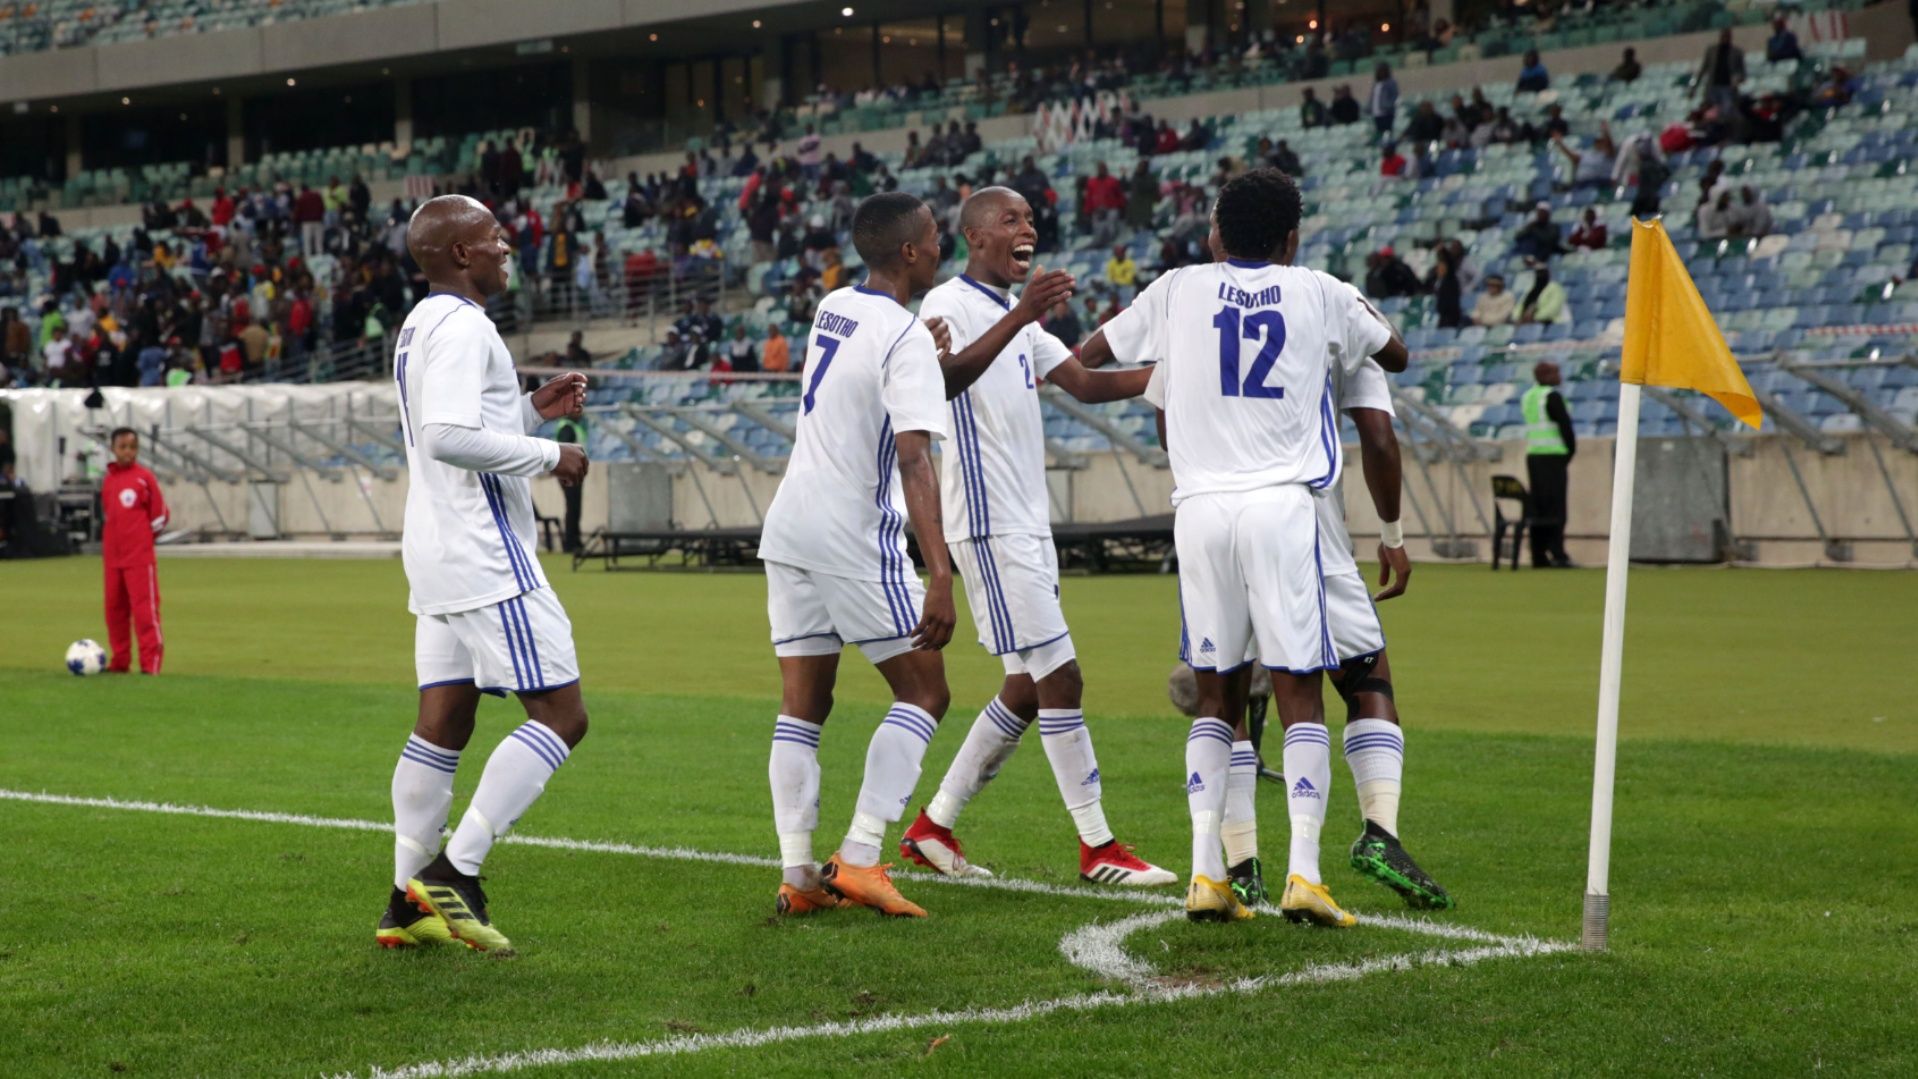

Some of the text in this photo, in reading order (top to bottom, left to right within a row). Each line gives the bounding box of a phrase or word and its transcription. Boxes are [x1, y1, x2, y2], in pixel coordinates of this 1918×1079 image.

[1218, 281, 1282, 309] LESOTHO
[815, 309, 859, 338] LESOTHO
[1213, 304, 1286, 400] 12
[803, 333, 841, 417] 7
[1018, 353, 1035, 390] 2
